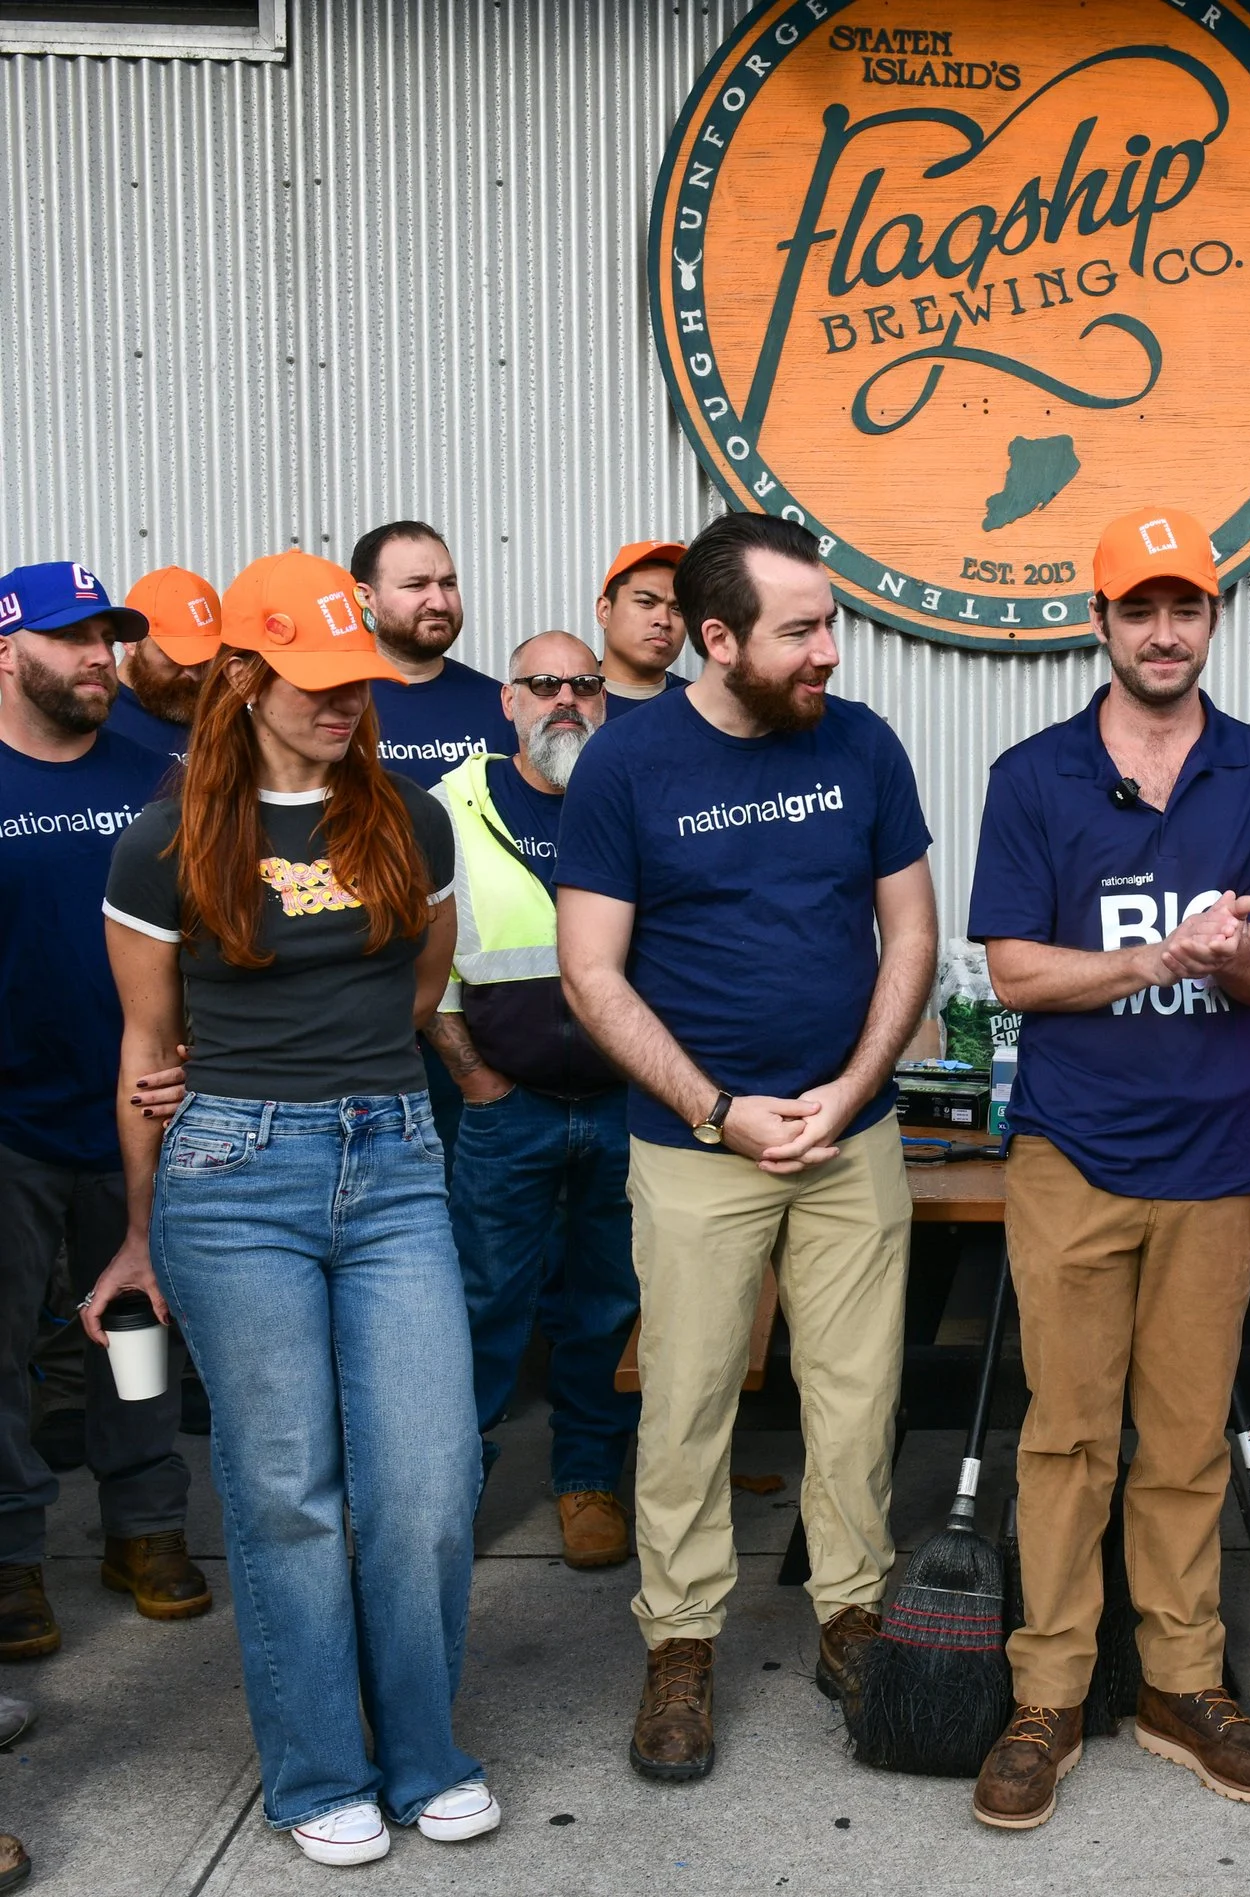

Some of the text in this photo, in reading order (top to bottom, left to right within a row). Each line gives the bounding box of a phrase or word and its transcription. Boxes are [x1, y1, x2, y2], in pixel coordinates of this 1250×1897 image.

[829, 25, 953, 56] STATEN
[862, 56, 1021, 91] ISLAND'S
[680, 0, 828, 229] UNFORGE
[820, 240, 1243, 354] BREWING CO.
[960, 557, 1076, 585] EST. 2013
[377, 735, 488, 762] tionalgrid
[0, 804, 144, 838] ationalgri
[678, 783, 844, 837] nationalgrid
[1101, 872, 1154, 887] nationalgrid
